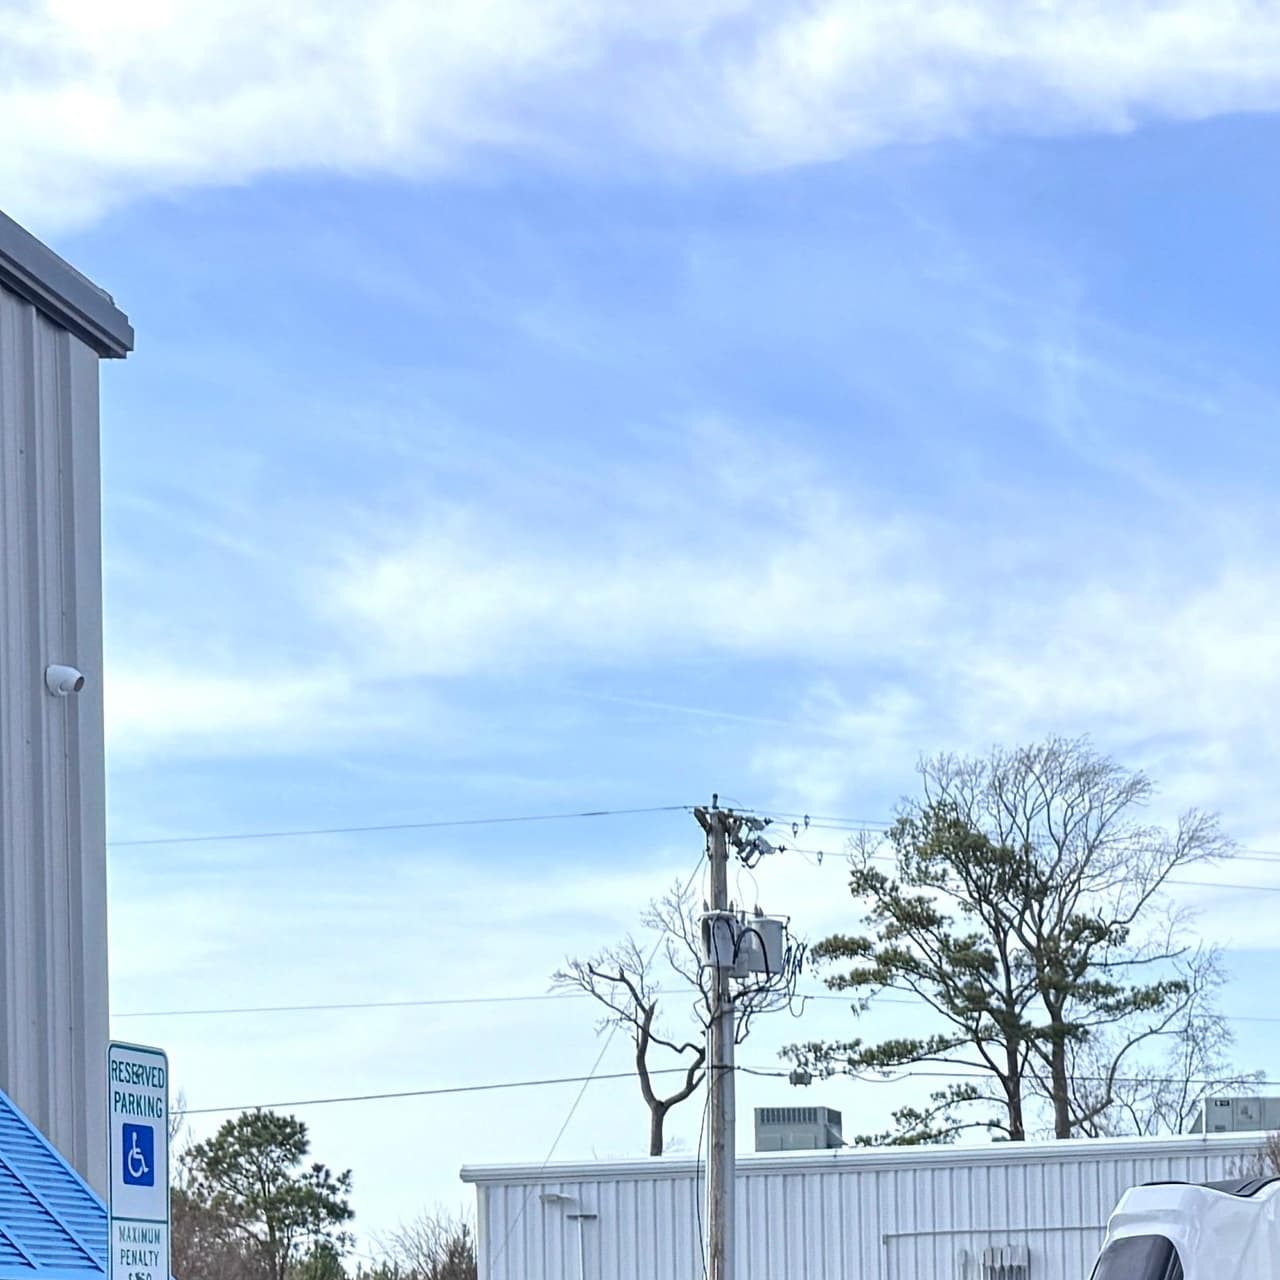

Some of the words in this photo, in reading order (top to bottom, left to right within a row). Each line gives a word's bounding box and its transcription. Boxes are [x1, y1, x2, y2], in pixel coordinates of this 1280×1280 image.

[112, 1059, 165, 1089] RESERVED
[114, 1091, 163, 1119] PARKING
[119, 1225, 161, 1245] MAXIMUM
[121, 1248, 160, 1267] PENALTY
